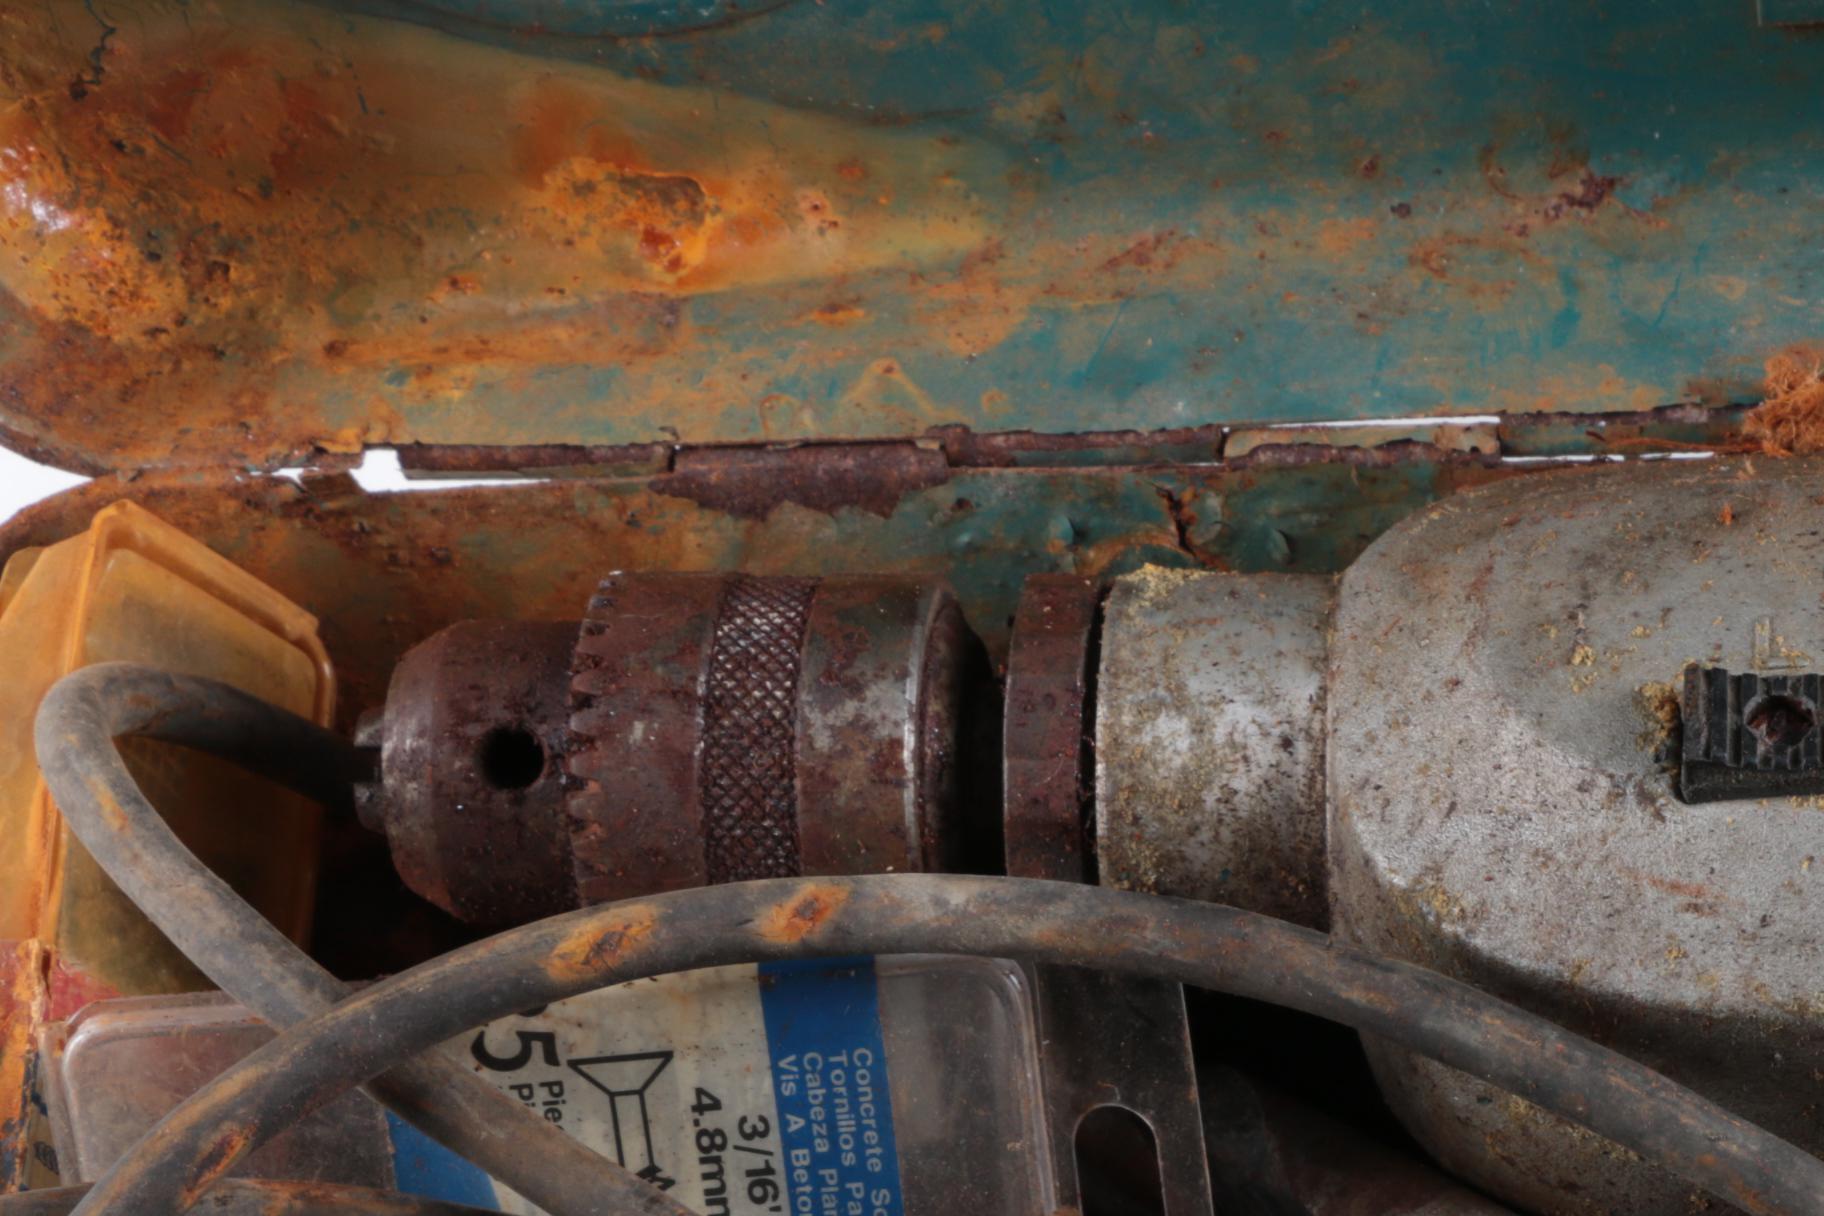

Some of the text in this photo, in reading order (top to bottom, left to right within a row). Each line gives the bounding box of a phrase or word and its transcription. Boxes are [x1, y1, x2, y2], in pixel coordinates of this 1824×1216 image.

[777, 1054, 800, 1097] Vis
[785, 1113, 806, 1133] A
[802, 1051, 831, 1153] Cabeza
[828, 1049, 857, 1167] Tornillos
[852, 1047, 884, 1173] Concrete
